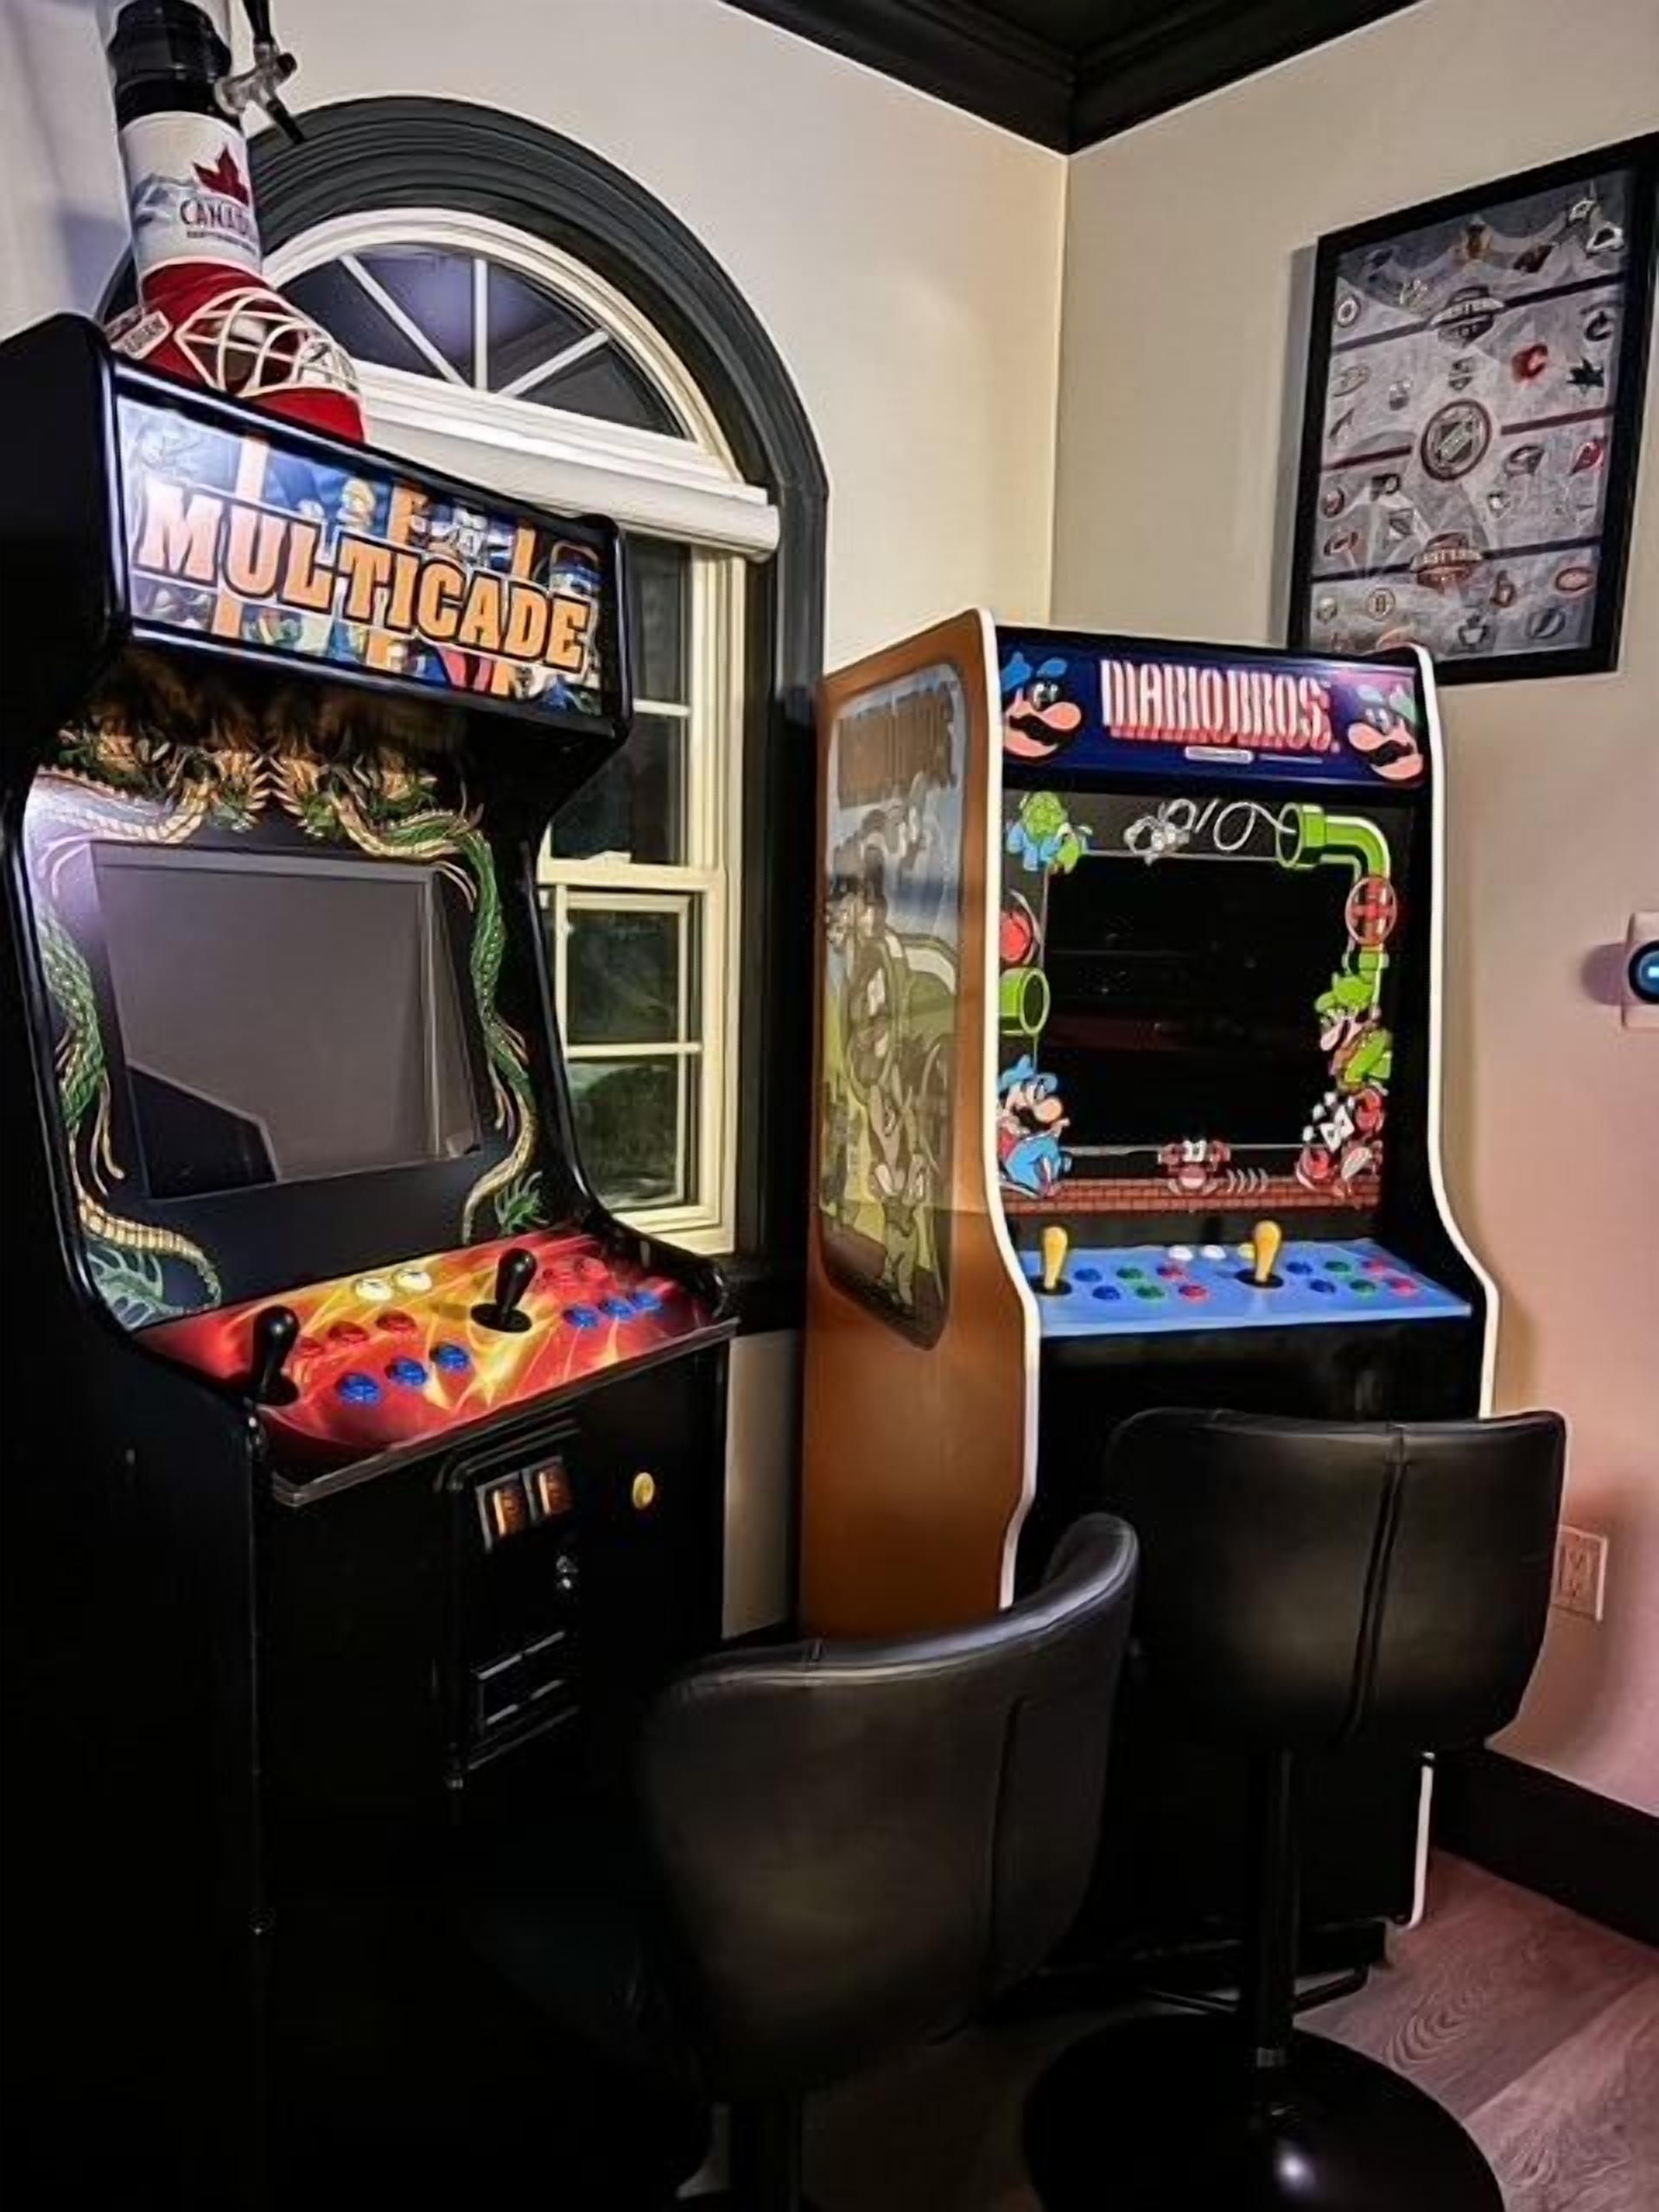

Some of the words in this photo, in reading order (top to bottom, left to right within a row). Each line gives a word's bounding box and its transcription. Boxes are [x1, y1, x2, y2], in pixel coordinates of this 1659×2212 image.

[135, 474, 592, 671] MULTICADE
[1100, 659, 1230, 744] MARIO
[1226, 669, 1340, 753] BROS.
